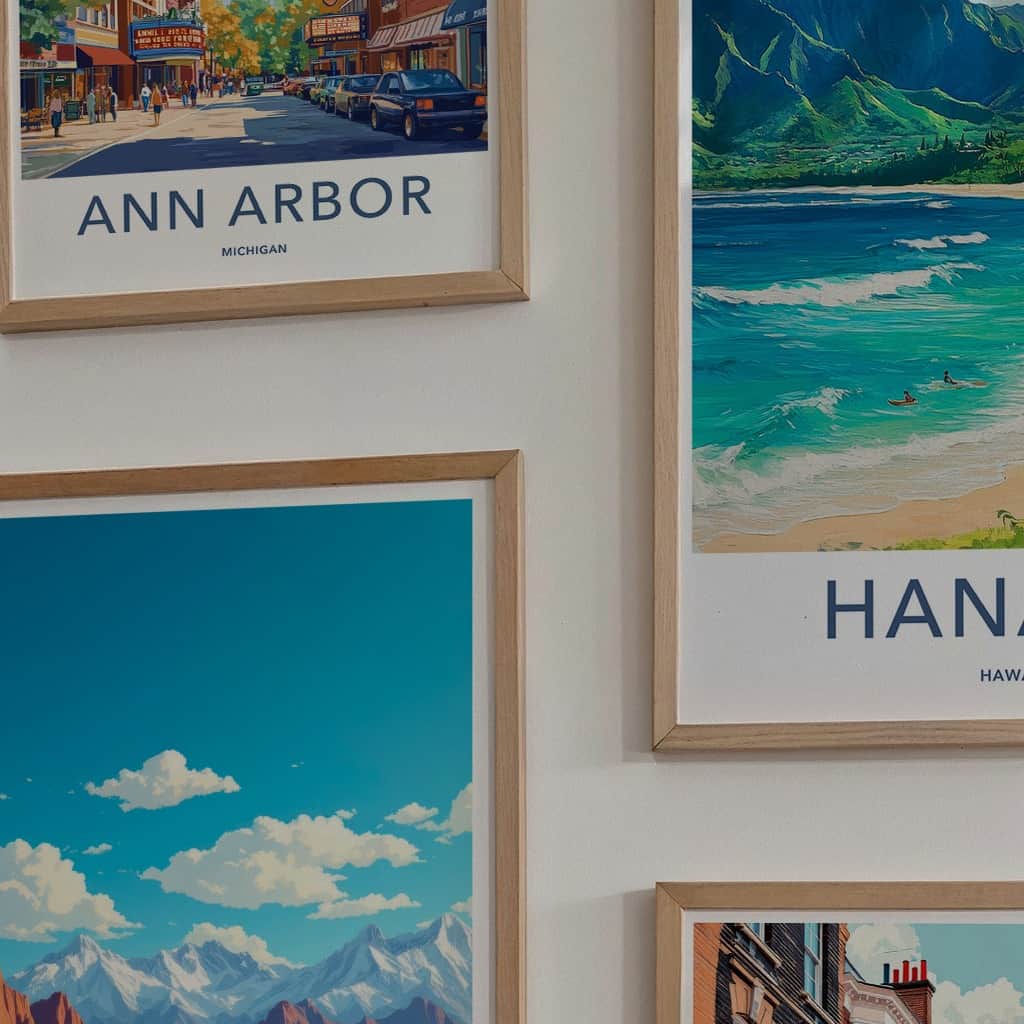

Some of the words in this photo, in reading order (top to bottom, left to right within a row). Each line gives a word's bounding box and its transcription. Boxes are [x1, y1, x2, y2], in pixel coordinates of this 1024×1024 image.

[77, 189, 204, 235] ANN
[228, 175, 432, 227] ARBOR
[221, 244, 288, 257] MICHIGAN
[826, 577, 1024, 640] HAN
[980, 668, 1024, 682] HAW
